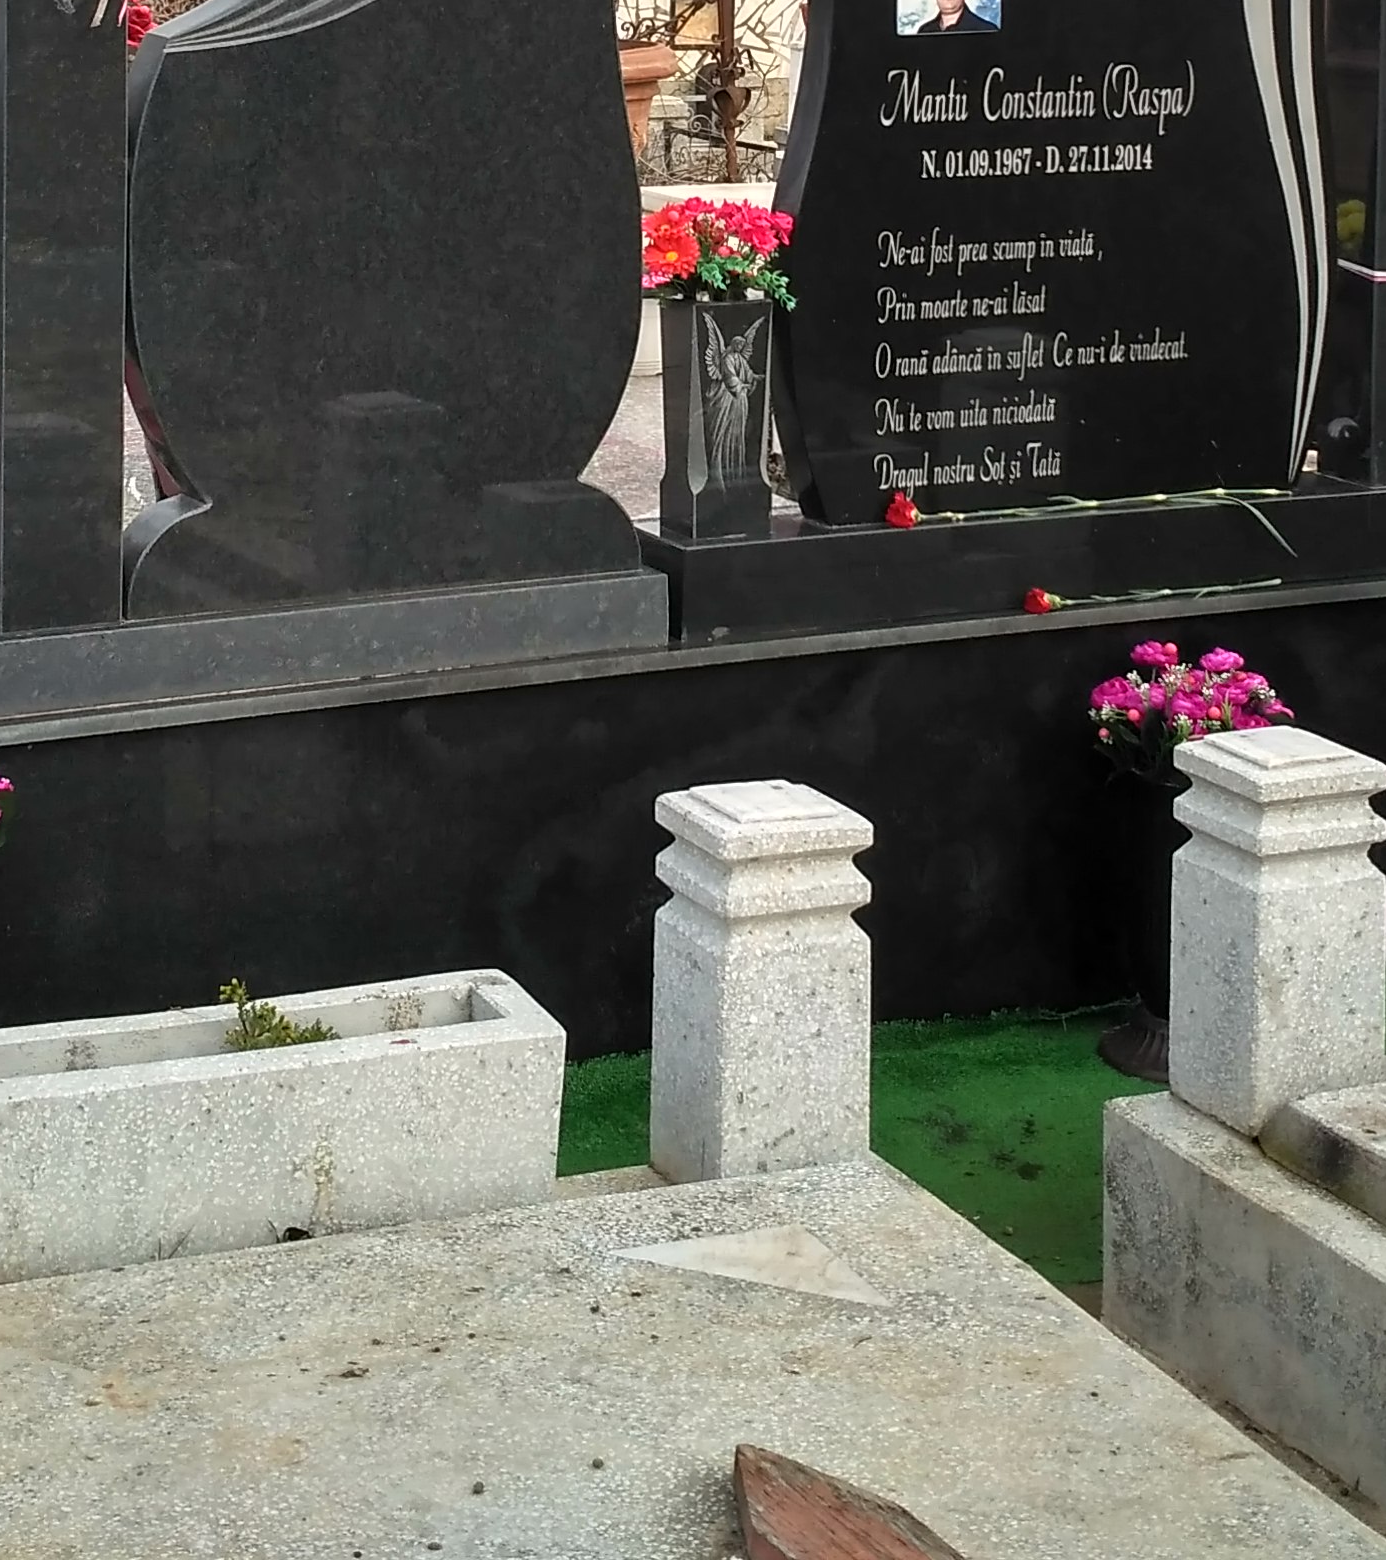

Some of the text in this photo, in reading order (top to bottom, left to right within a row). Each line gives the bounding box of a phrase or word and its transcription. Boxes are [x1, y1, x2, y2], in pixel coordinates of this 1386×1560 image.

[983, 67, 1096, 122] Constantin
[1102, 59, 1195, 136] (Raspa)
[921, 150, 941, 179] N.
[945, 147, 1033, 178] 01.09.1967
[1045, 145, 1064, 174] D.
[1068, 143, 1153, 173] 27.11.2014
[878, 231, 925, 268] Ne-ai
[926, 226, 954, 276] fost
[957, 240, 989, 276] prea
[992, 239, 1037, 272] scump
[877, 286, 916, 324] Prin
[920, 289, 969, 320] moarte
[972, 288, 1009, 317] ne-ai
[875, 342, 893, 379] O
[1006, 332, 1044, 381] suflet
[1053, 332, 1074, 368] Ce
[1077, 336, 1107, 366] nu-i
[1109, 329, 1126, 364] de
[1129, 327, 1189, 361] vindecat.
[875, 398, 905, 436] Nu
[909, 402, 922, 432] te
[926, 409, 955, 430] vom
[873, 451, 929, 501] Dragul
[933, 454, 976, 485] nostru
